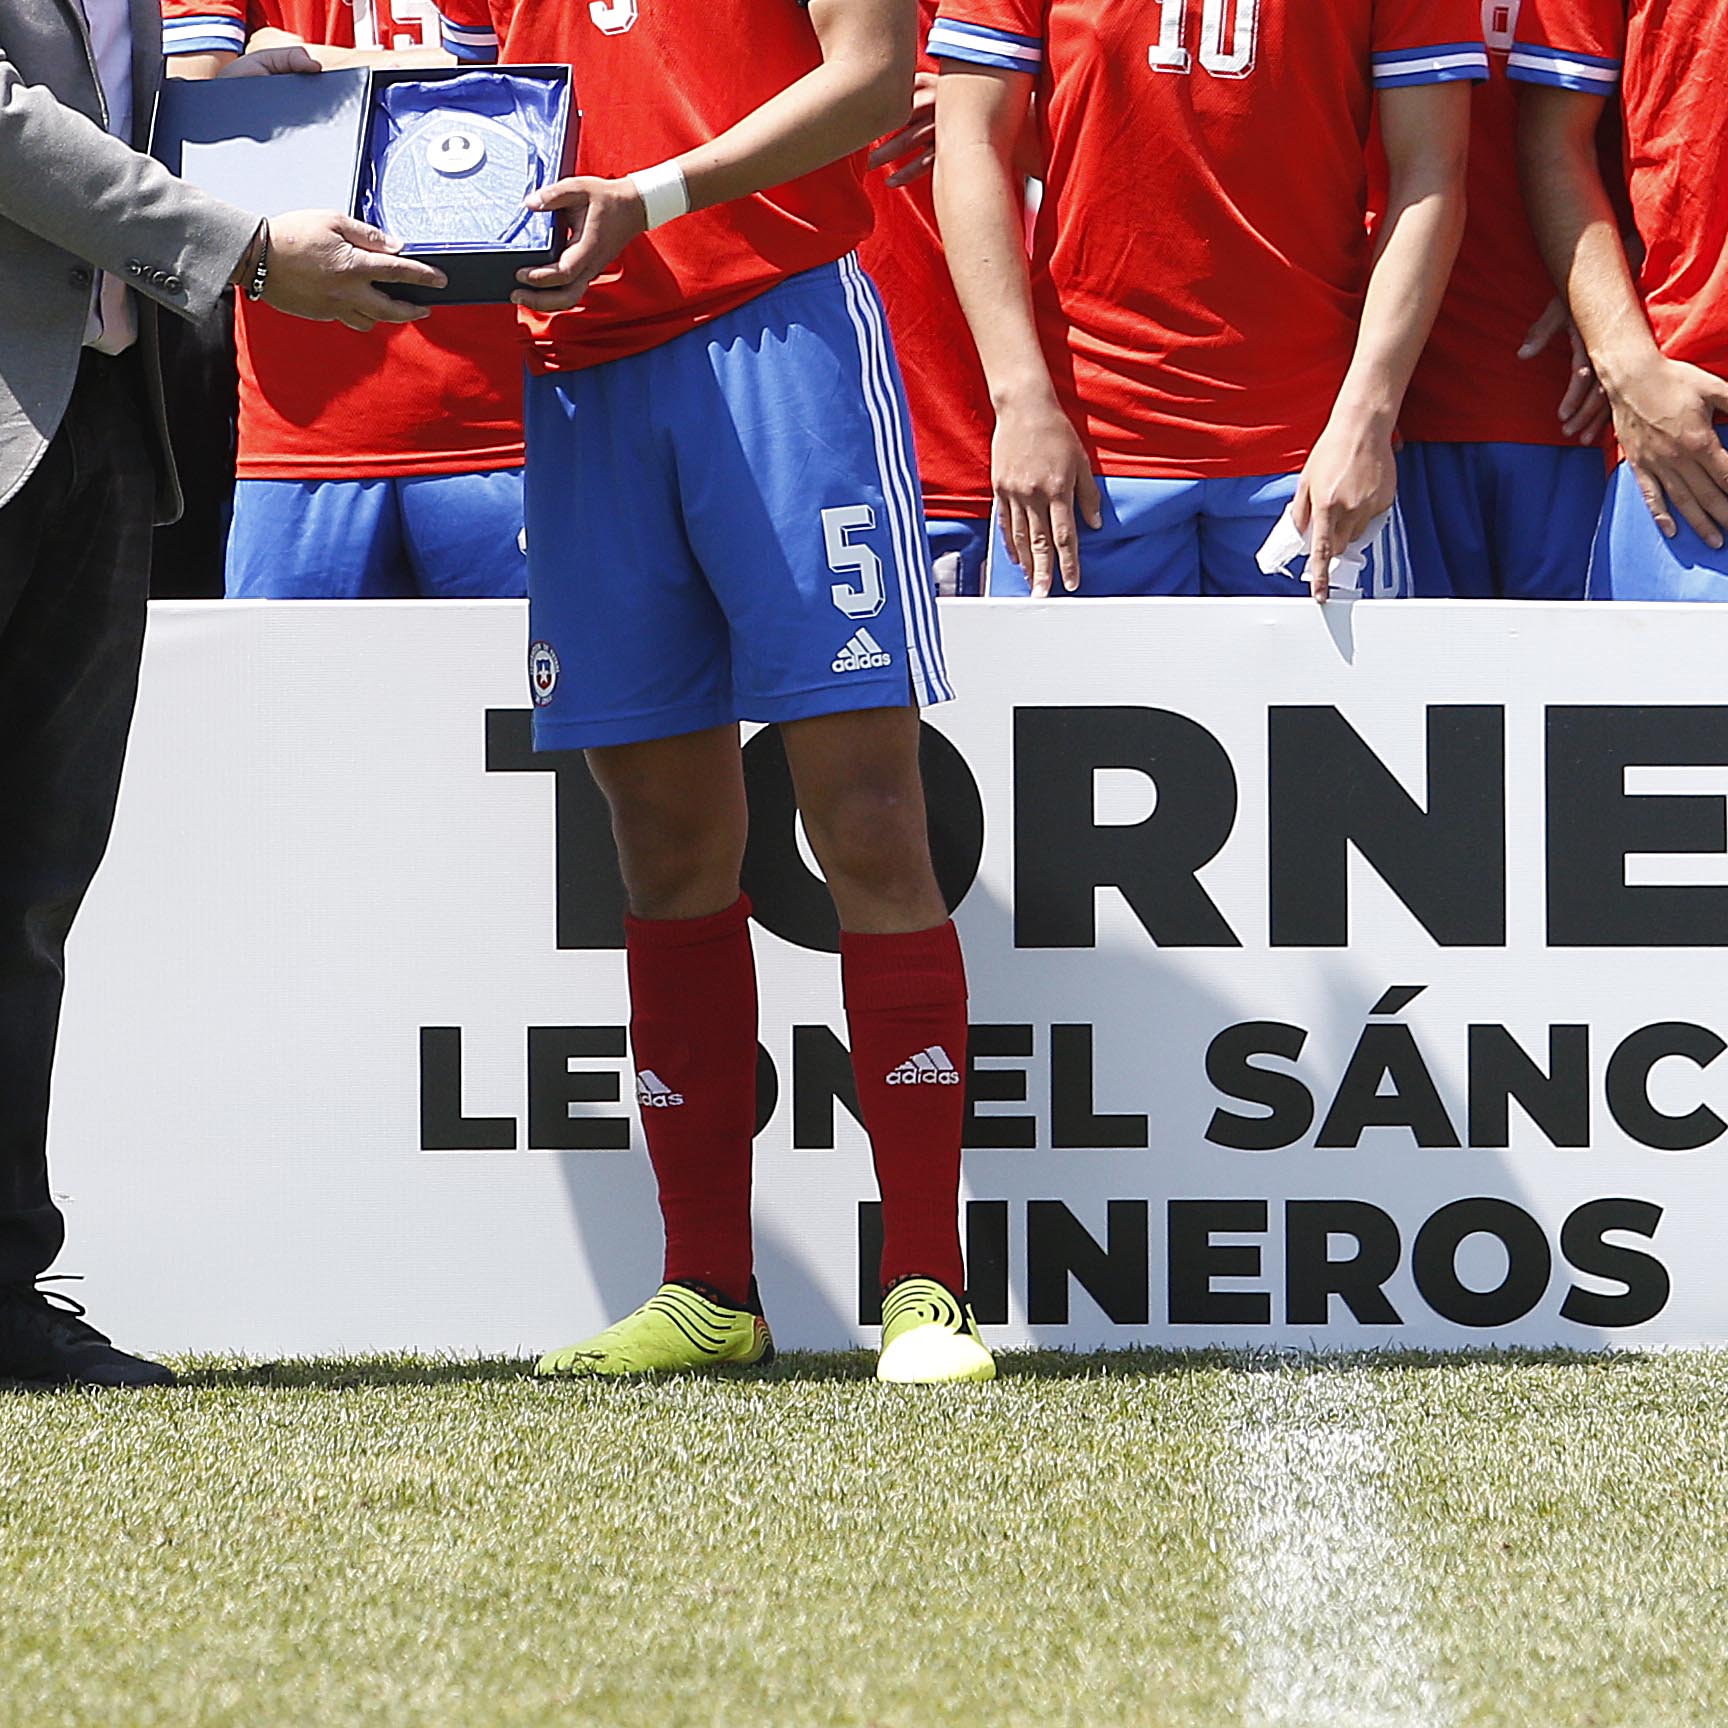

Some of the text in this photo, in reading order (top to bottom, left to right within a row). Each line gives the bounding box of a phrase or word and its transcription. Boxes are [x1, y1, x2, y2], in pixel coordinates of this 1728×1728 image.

[820, 504, 887, 620] 5
[831, 652, 892, 673] adidas
[886, 1068, 960, 1085] adidas
[419, 1024, 1148, 1152] LENEL
[639, 1091, 684, 1108] das
